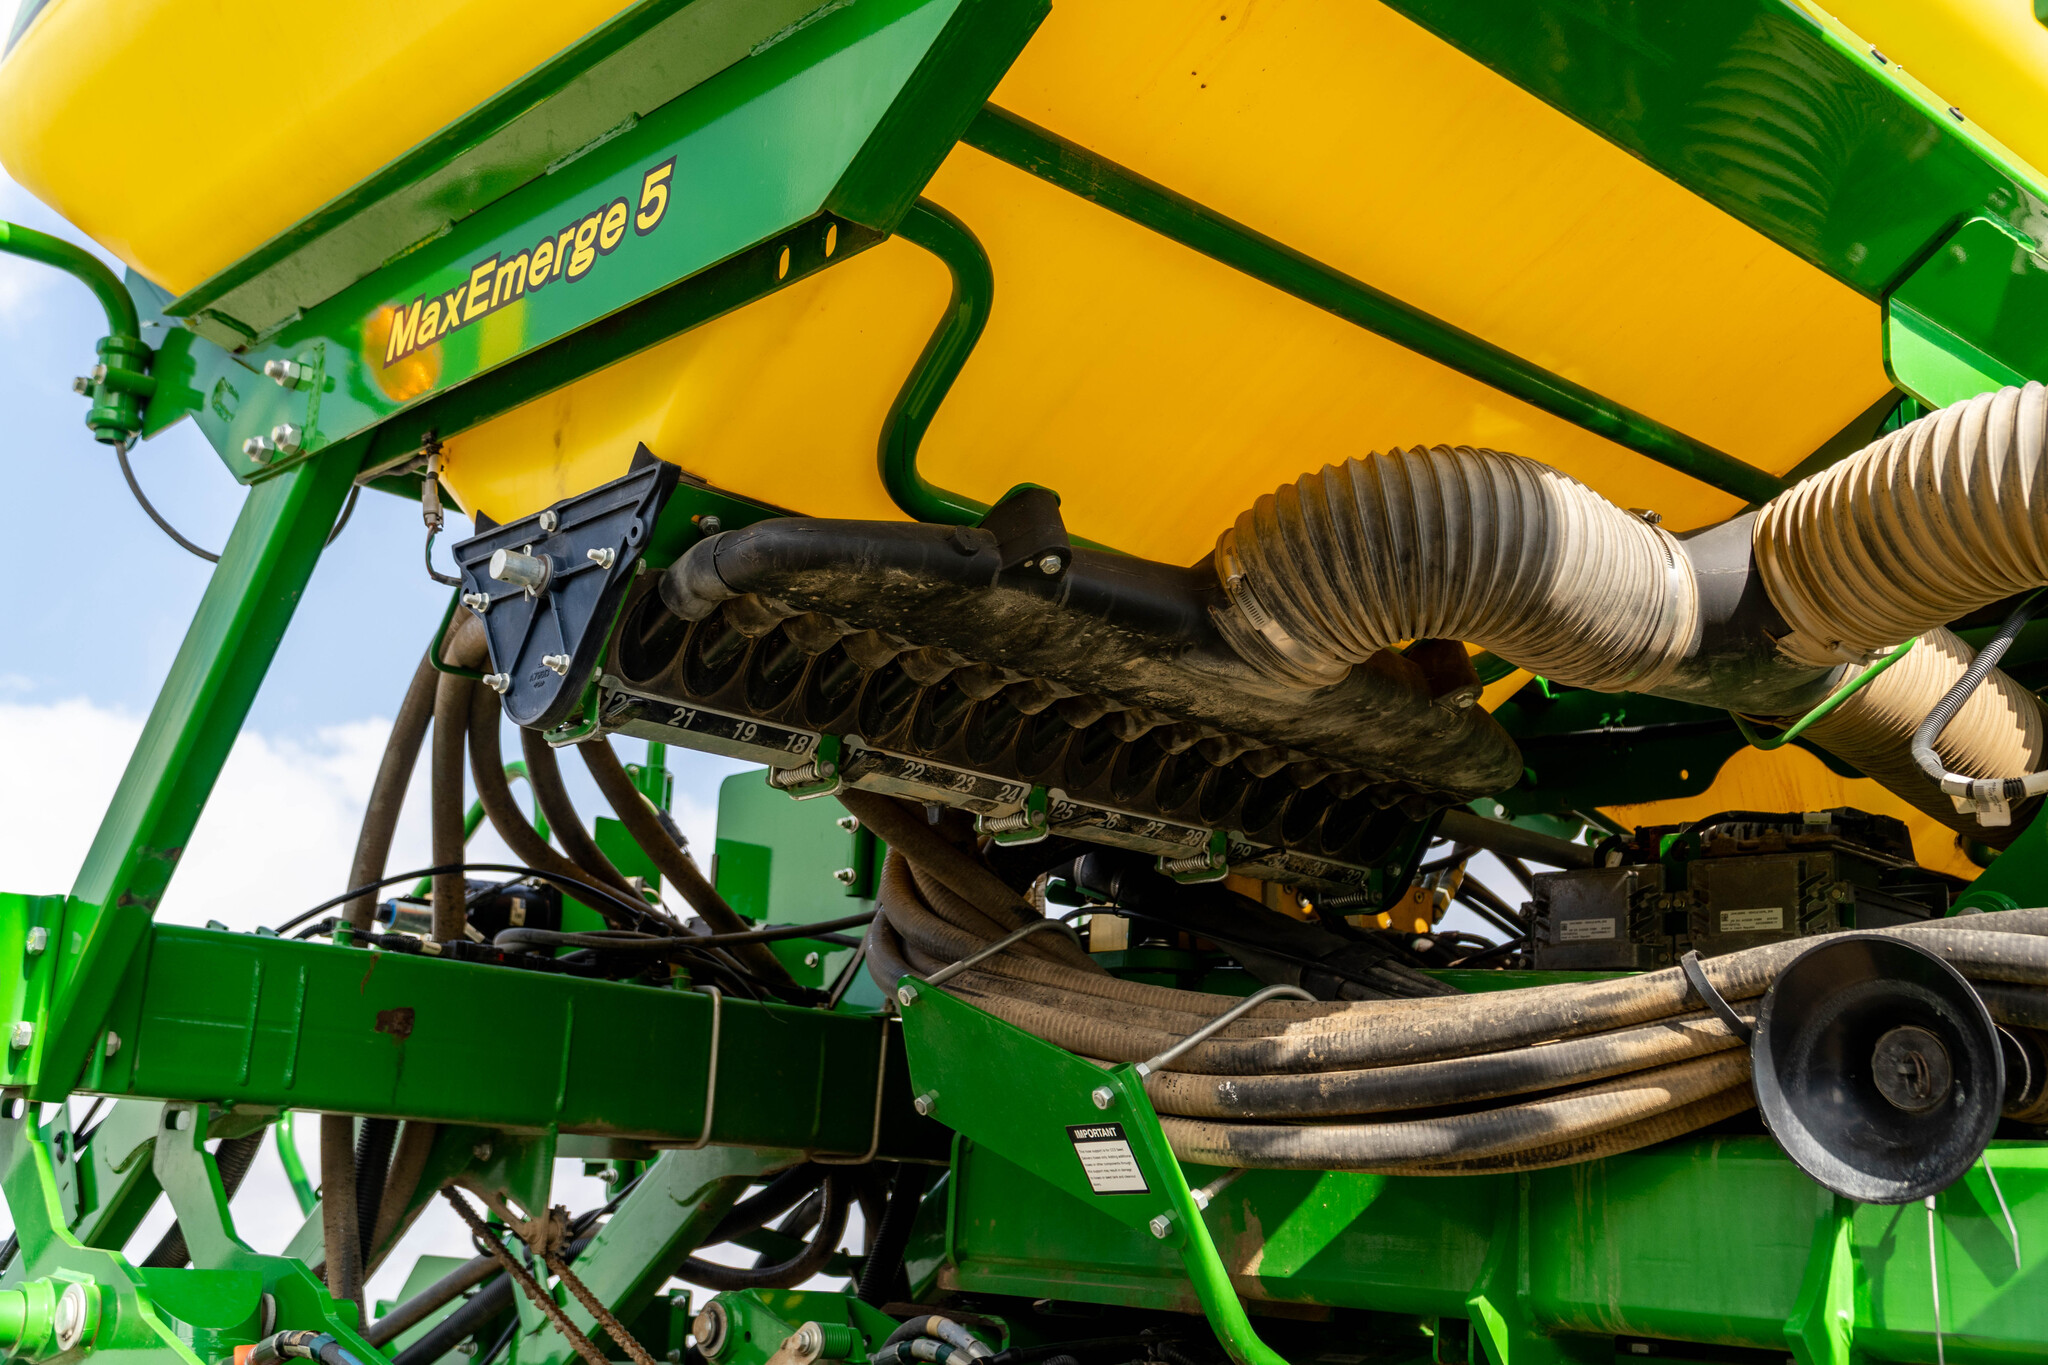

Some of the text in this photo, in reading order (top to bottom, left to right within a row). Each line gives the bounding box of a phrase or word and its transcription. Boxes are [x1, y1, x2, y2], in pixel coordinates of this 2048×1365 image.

[384, 159, 675, 366] MaxEmerge 5
[667, 707, 697, 729] 21
[732, 721, 758, 742] 19
[783, 733, 809, 754] 18
[899, 761, 1021, 803] 22 23 24
[1050, 801, 1205, 847] 25 26 27 28
[1340, 869, 1362, 884] 32
[1073, 1127, 1117, 1139] IMPORTANT
